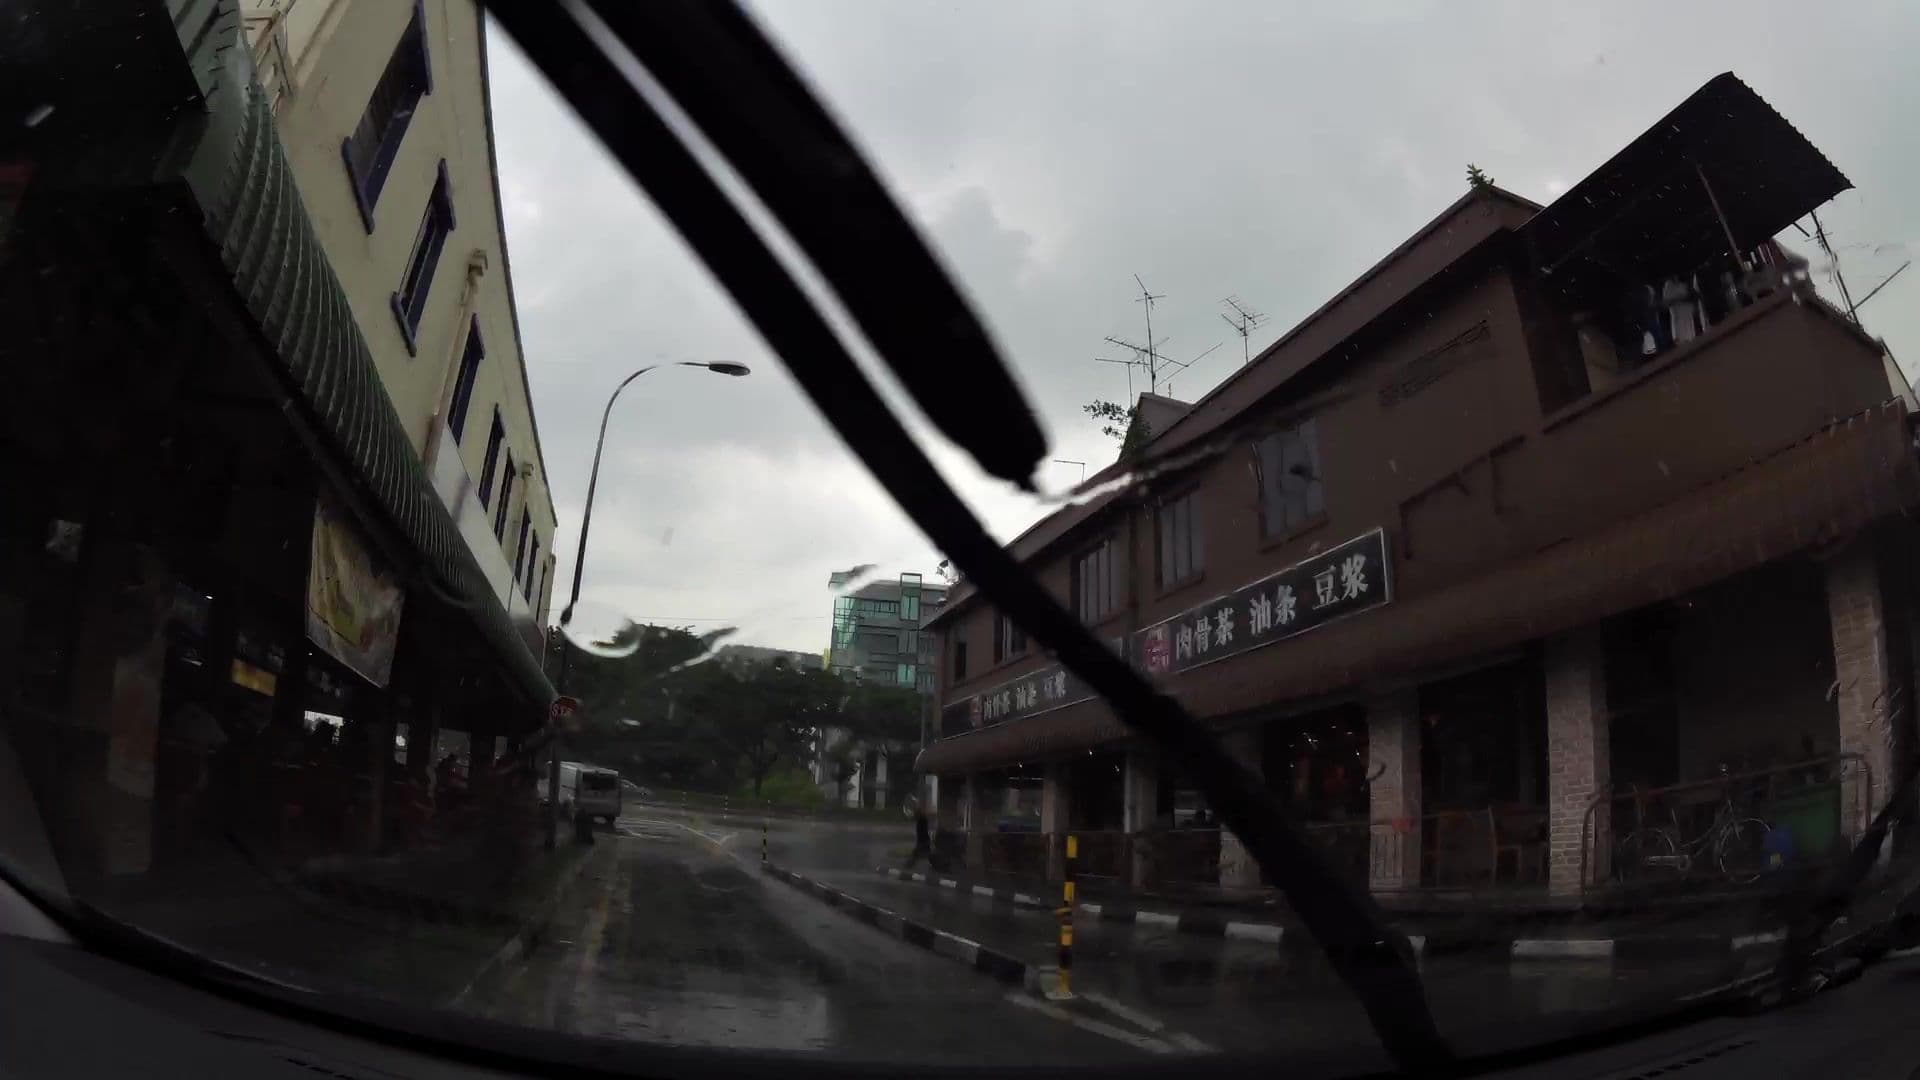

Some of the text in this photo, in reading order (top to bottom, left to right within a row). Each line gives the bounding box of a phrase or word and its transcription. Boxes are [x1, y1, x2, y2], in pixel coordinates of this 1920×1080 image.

[1176, 607, 1235, 660] 肉骨茶
[1249, 584, 1297, 636] 油条
[1312, 553, 1369, 610] 豆浆
